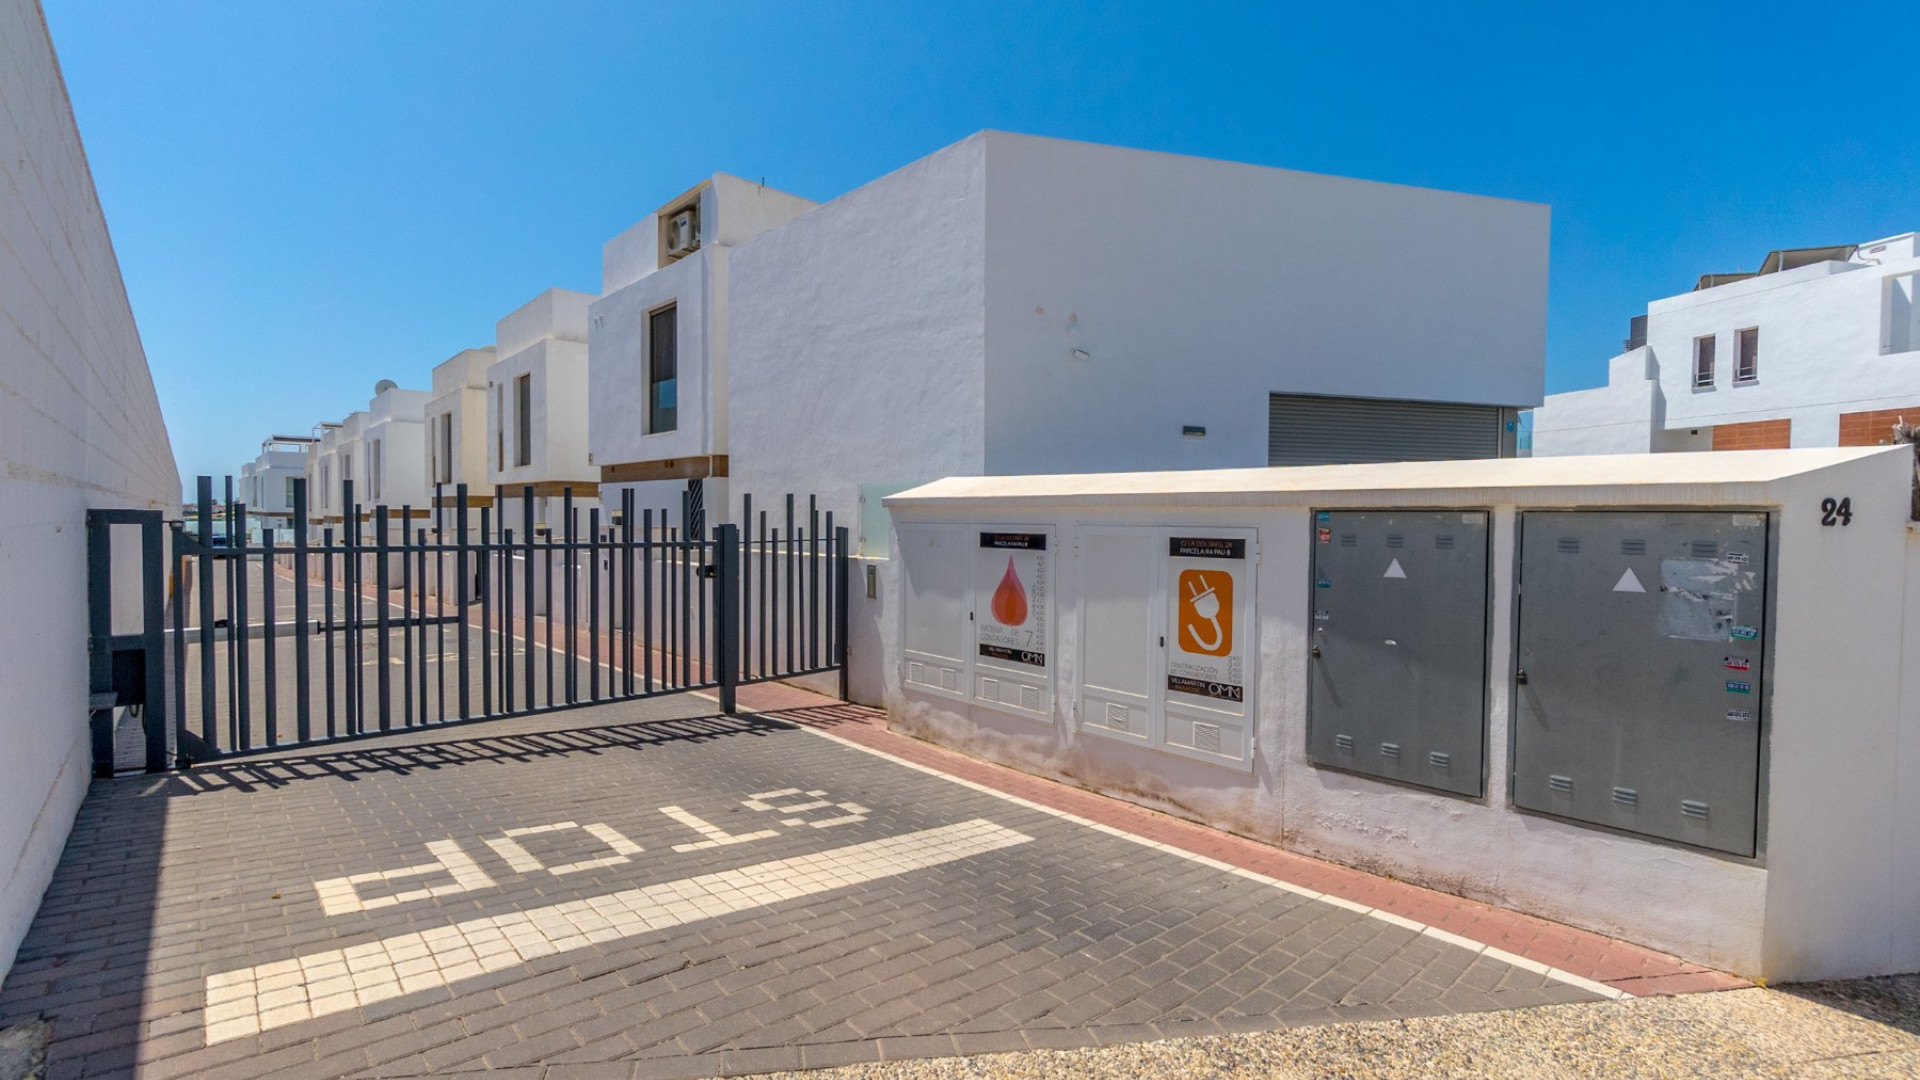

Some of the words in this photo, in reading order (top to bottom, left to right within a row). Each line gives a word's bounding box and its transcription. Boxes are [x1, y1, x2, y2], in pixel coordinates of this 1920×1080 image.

[1821, 497, 1853, 526] 24
[1180, 547, 1205, 555] PARCELA
[1024, 630, 1034, 647] 7
[314, 787, 873, 918] STOP
